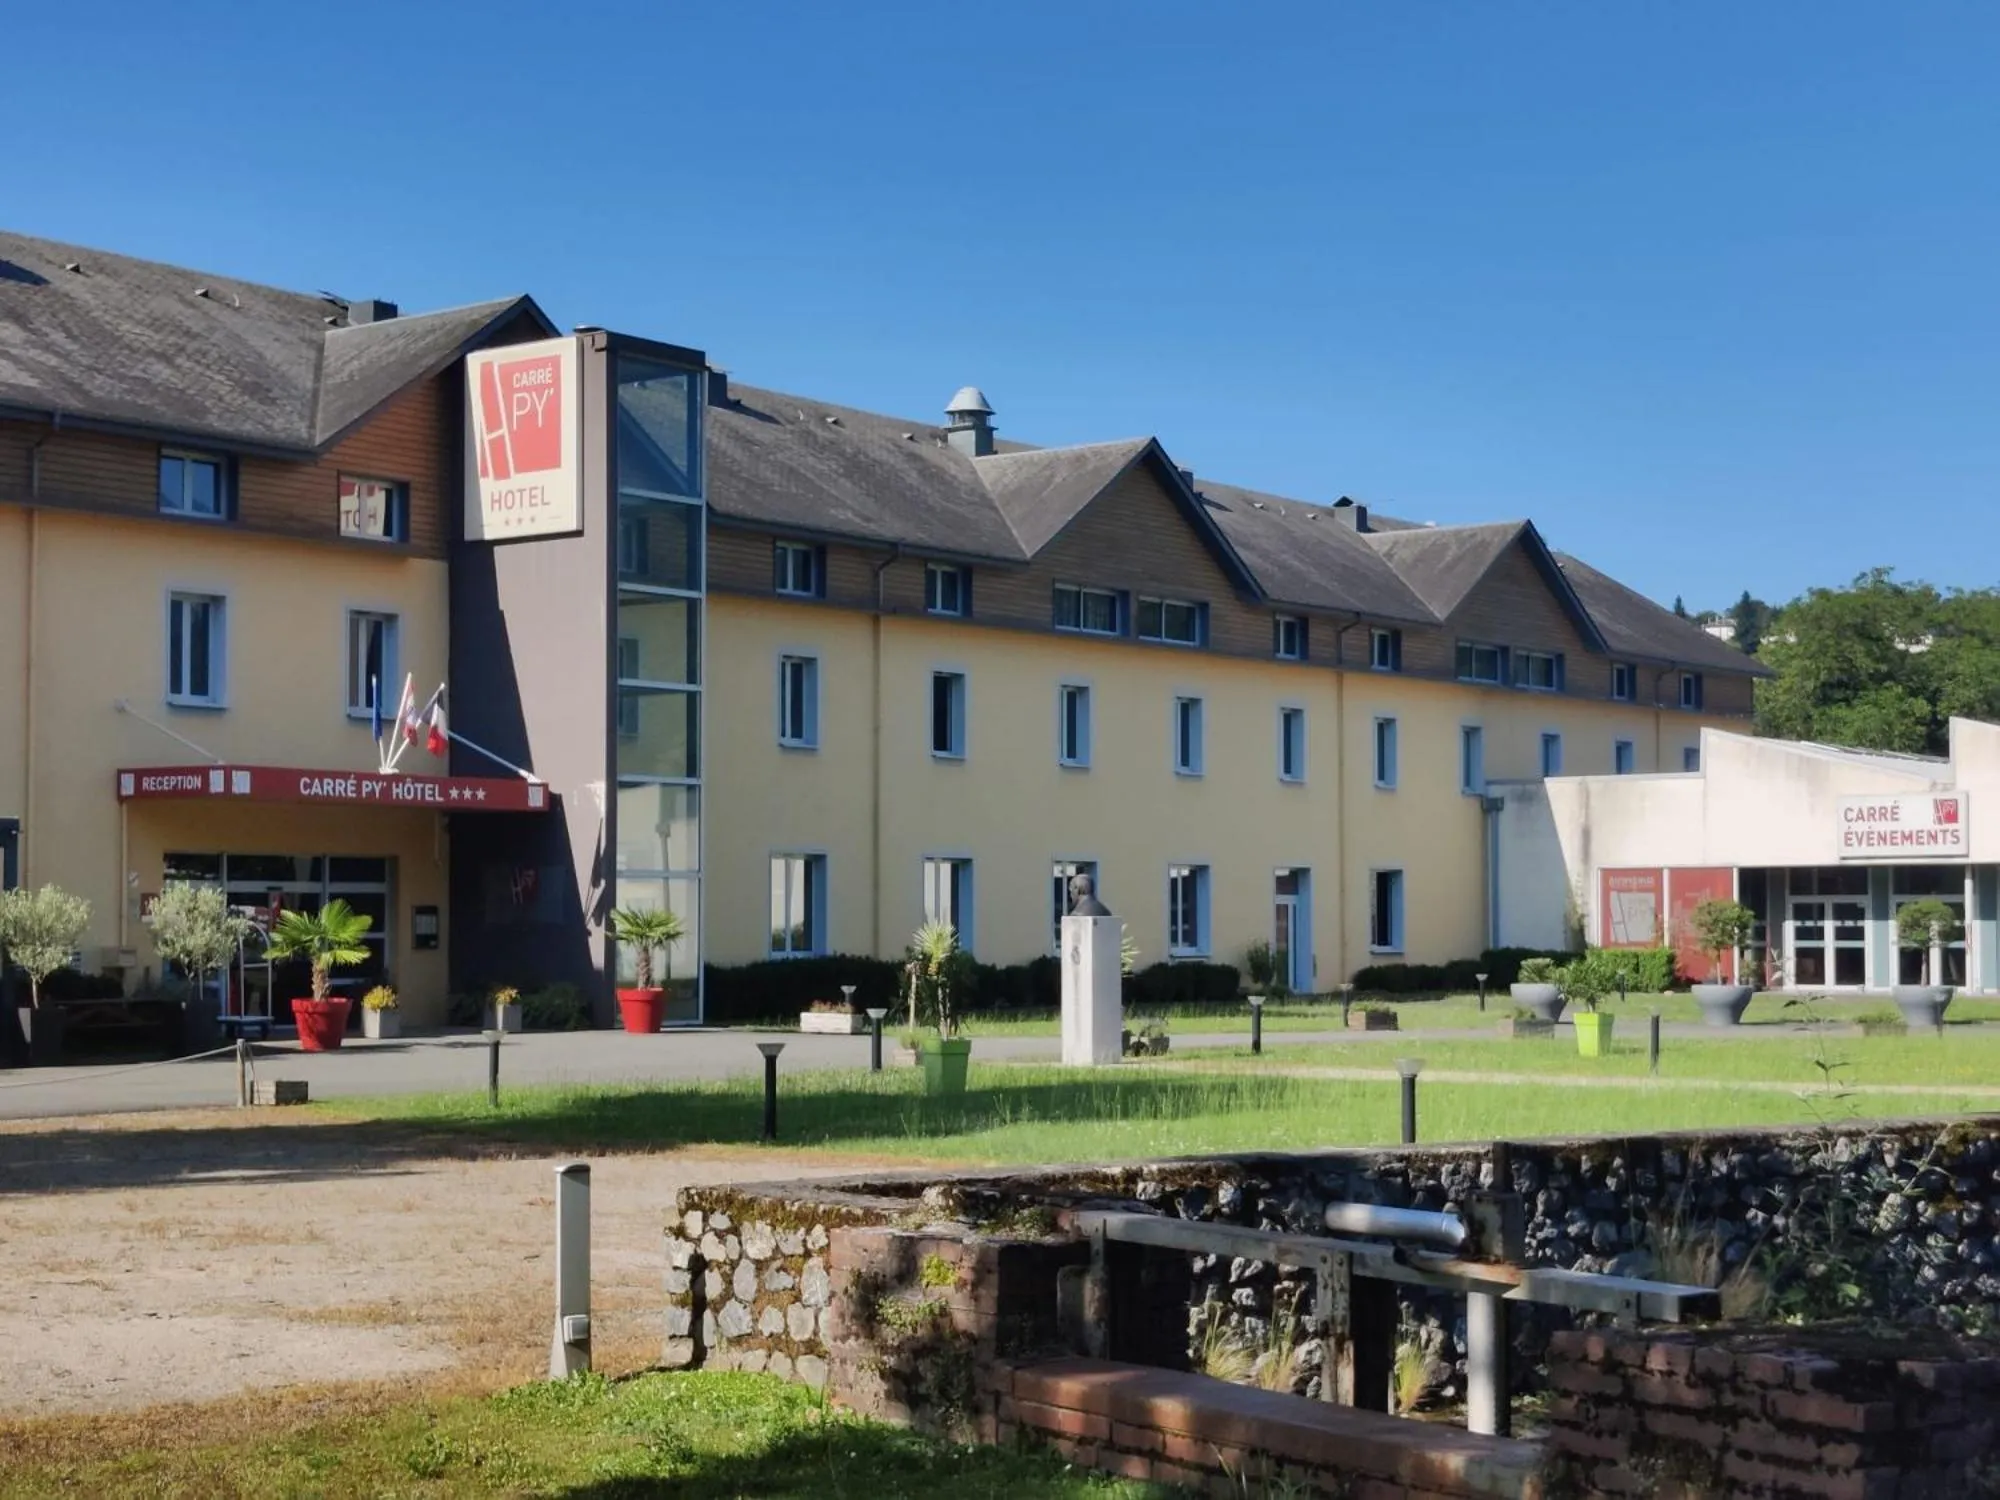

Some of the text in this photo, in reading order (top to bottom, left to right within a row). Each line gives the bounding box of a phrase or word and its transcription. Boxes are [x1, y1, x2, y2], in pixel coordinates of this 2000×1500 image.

[513, 363, 553, 388] CARRÉ
[490, 485, 551, 512] HOTEL
[142, 775, 202, 791] RECEPTION
[300, 774, 357, 798] CARRÉ
[392, 777, 444, 801] HÔTEL
[1843, 800, 1901, 823] CARRÉ
